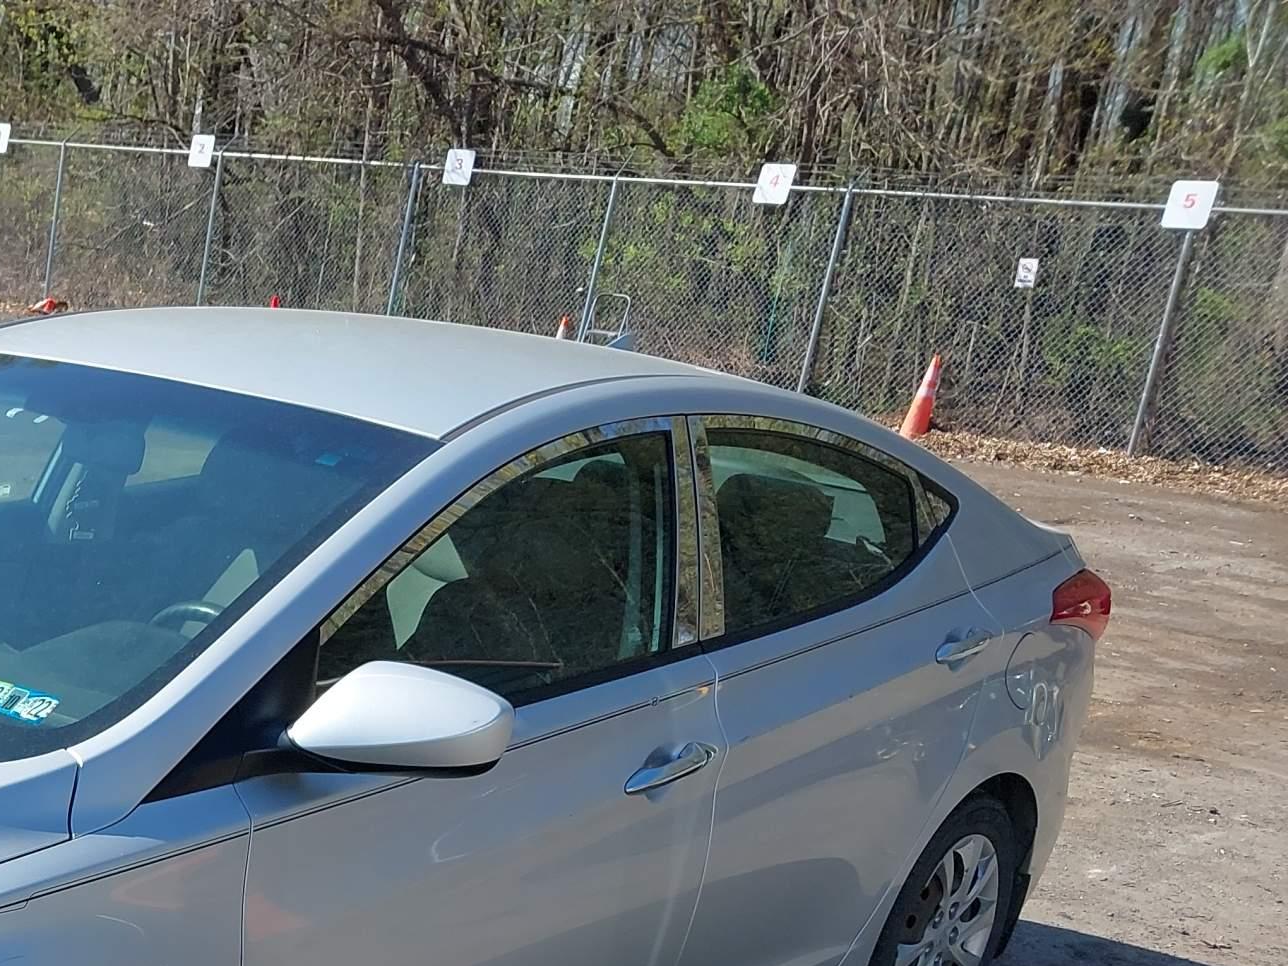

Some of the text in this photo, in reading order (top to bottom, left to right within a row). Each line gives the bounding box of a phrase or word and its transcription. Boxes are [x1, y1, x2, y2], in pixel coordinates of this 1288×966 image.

[198, 143, 206, 154] 2
[455, 158, 464, 170] 3
[769, 174, 781, 188] 4
[1183, 193, 1198, 209] 5
[27, 698, 52, 718] 22
